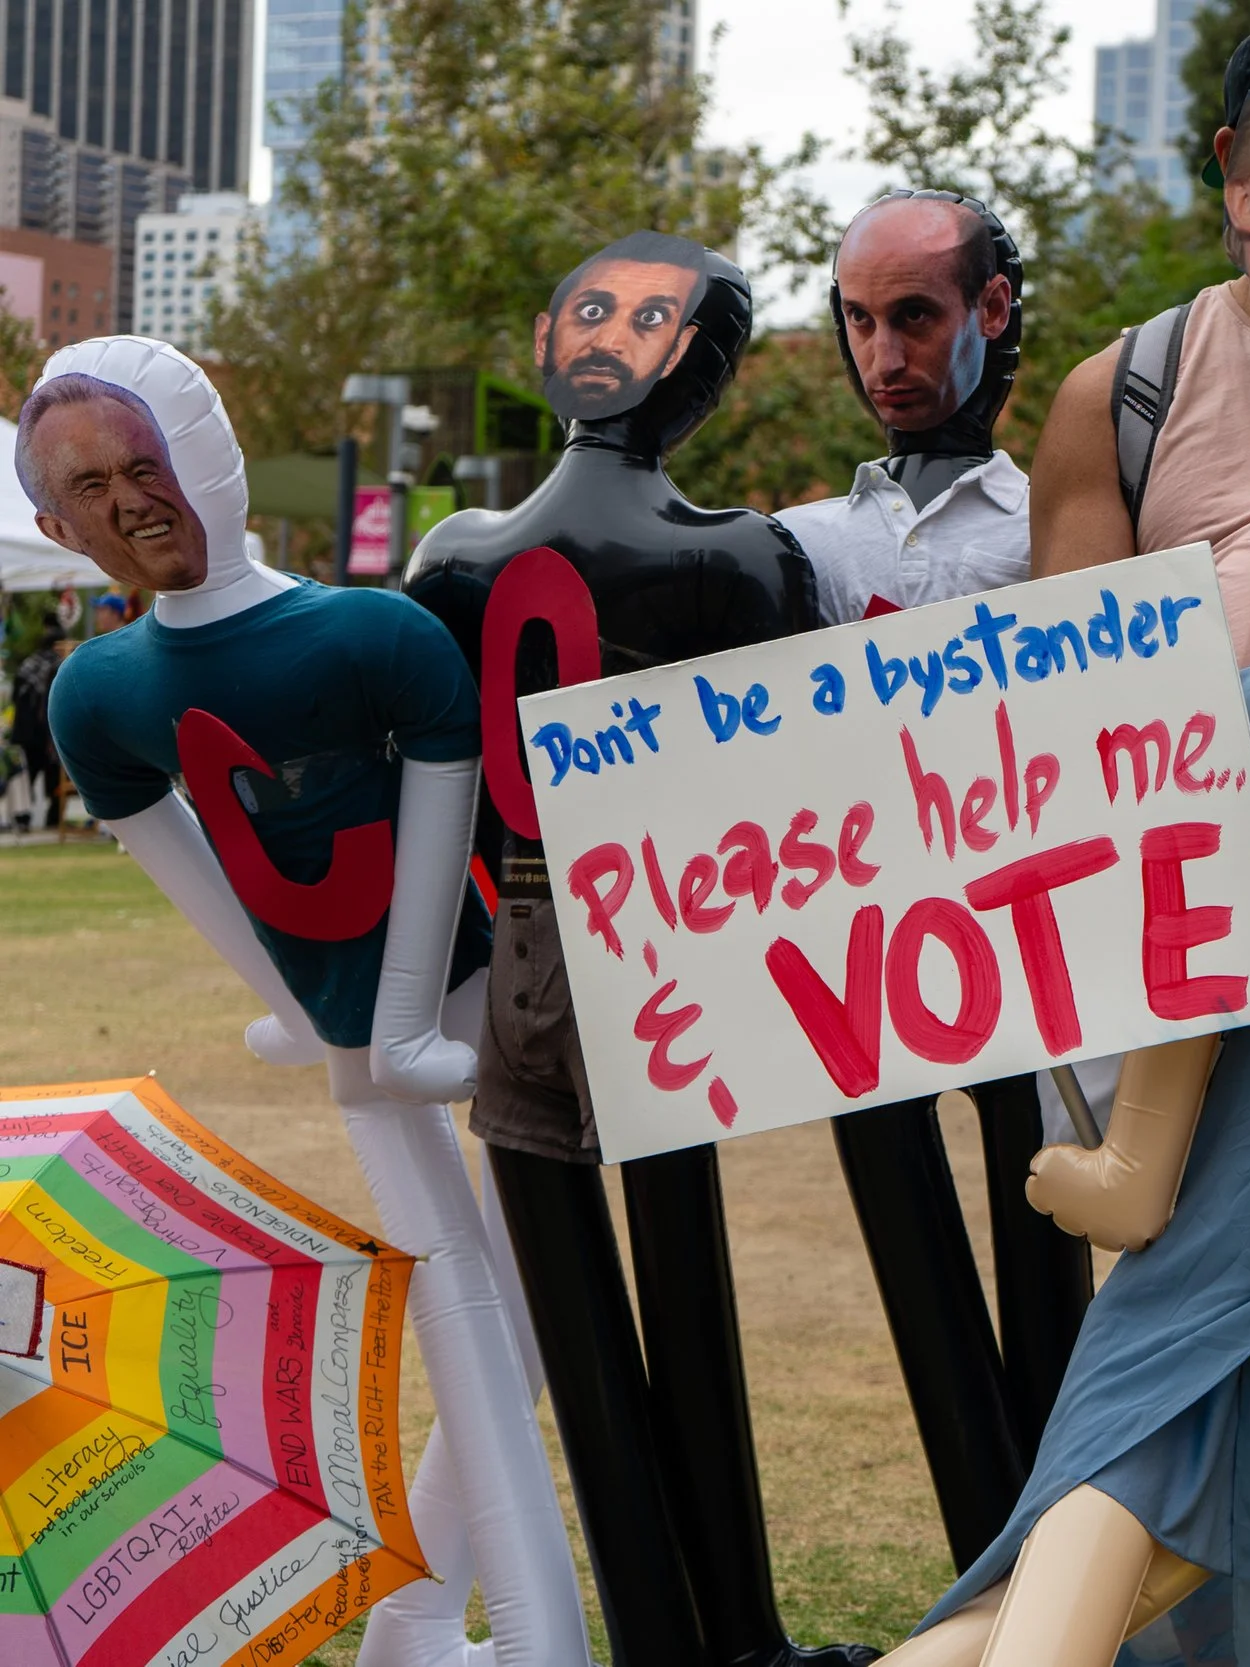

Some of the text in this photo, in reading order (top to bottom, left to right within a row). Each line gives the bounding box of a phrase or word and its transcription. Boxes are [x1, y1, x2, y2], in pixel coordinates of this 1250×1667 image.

[531, 589, 1201, 786] Don't be a bystander
[177, 708, 394, 941] C
[567, 801, 881, 962] Please
[898, 701, 1060, 861] help
[765, 822, 1250, 1099] VOTE
[97, 1132, 153, 1175] Profit
[26, 1202, 128, 1281] Freedom
[81, 1152, 227, 1263] Voting Rights
[202, 1209, 281, 1260] People
[211, 1181, 330, 1254] INDIGENOUS
[61, 1311, 92, 1373] ICE
[276, 1356, 304, 1423] WARS
[28, 1427, 144, 1509] Literacy
[31, 1442, 155, 1545] End Book Banning
[280, 1433, 313, 1488] END
[371, 1443, 388, 1477] the
[59, 1463, 146, 1538] in our schools
[168, 1491, 240, 1561] Rights
[373, 1479, 397, 1519] TAX
[219, 1540, 329, 1636] Justice
[325, 1552, 358, 1628] Recovery
